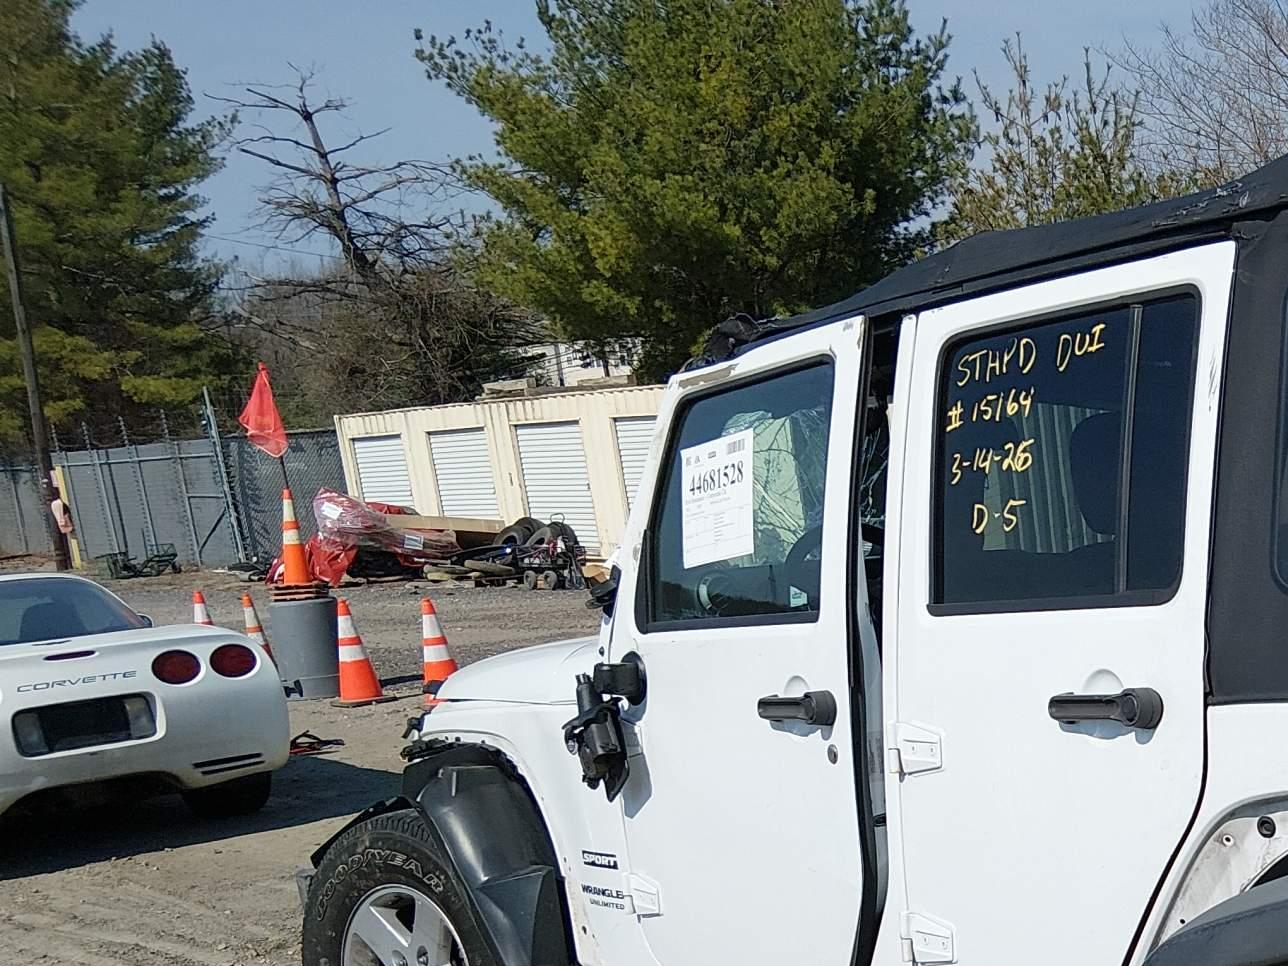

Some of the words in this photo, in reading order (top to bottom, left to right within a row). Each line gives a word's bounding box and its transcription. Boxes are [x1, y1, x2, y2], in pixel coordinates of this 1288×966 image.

[1056, 323, 1106, 373] DUI
[689, 459, 744, 497] 44681528
[972, 499, 1027, 535] D-5
[16, 670, 138, 693] CORVETTE
[582, 852, 618, 868] SPORT
[315, 847, 445, 922] GOODYEAR
[589, 897, 625, 911] UNLIMITED
